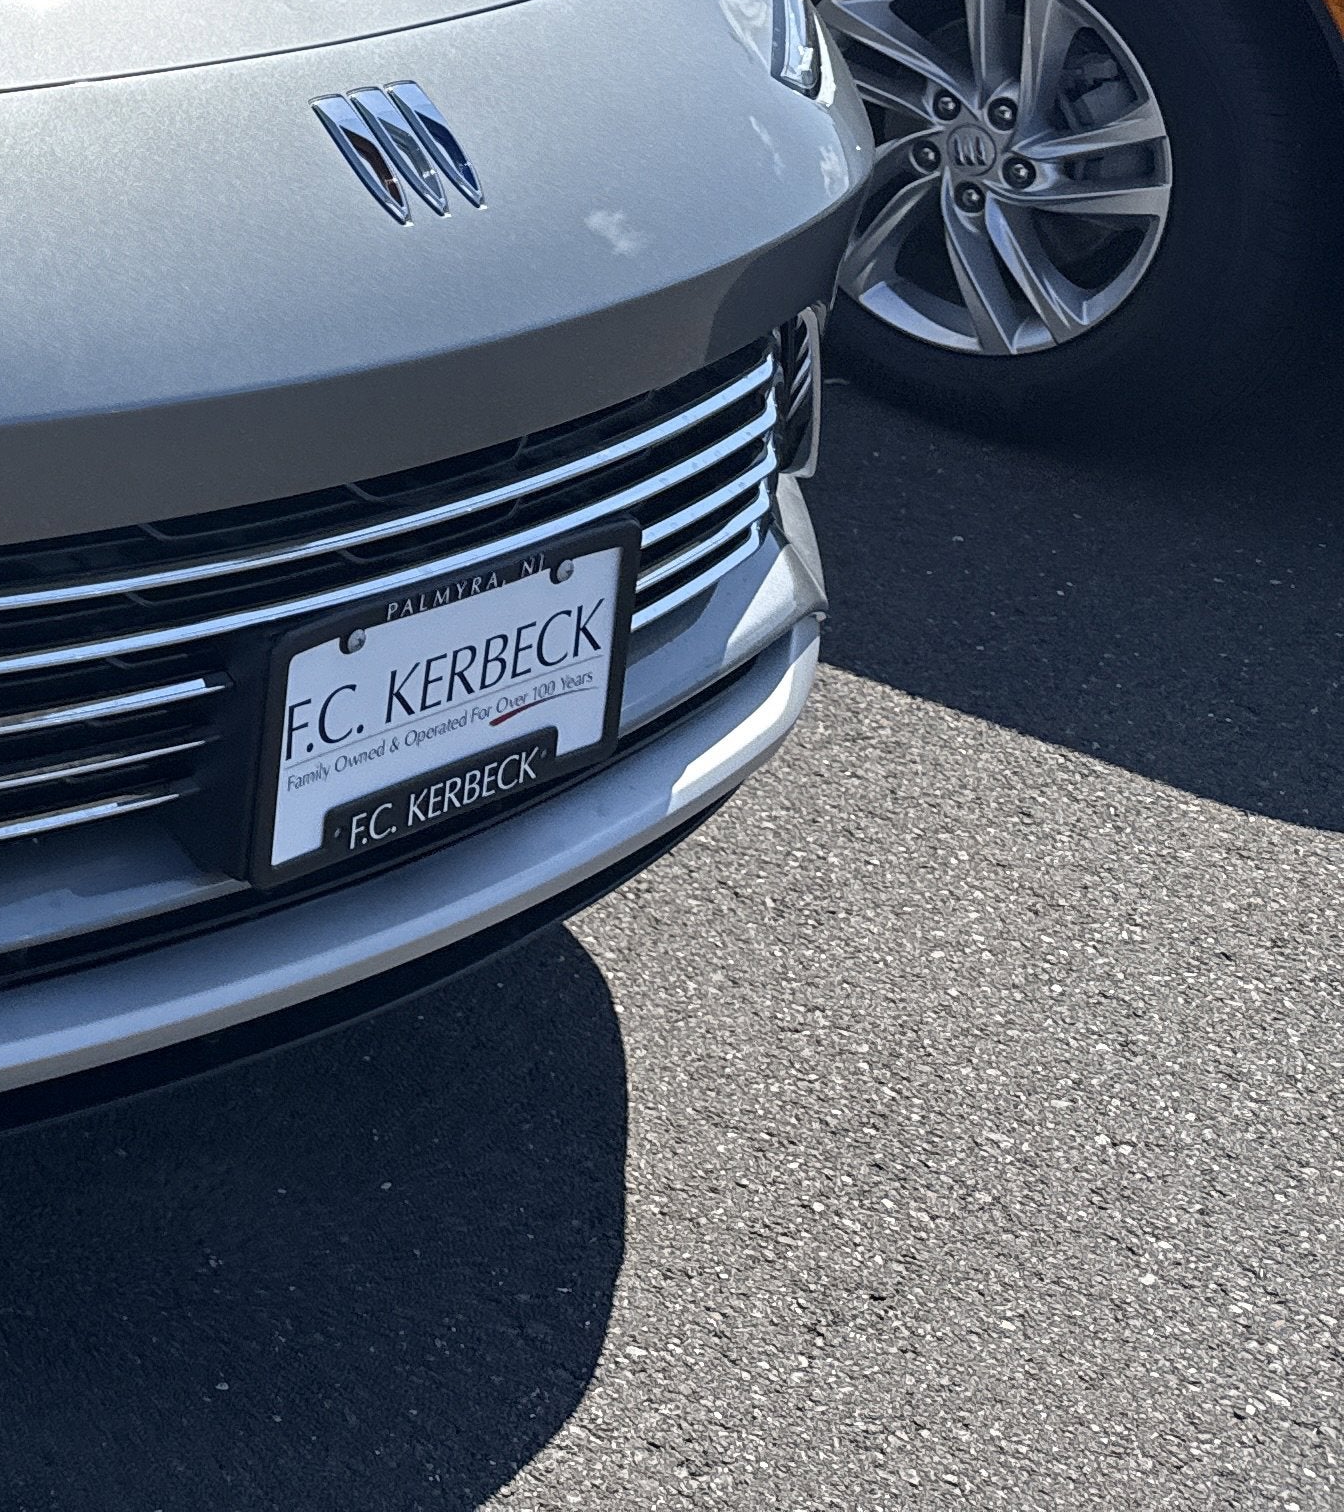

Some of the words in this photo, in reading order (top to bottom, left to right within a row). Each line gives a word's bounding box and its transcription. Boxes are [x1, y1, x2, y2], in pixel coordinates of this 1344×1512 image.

[387, 571, 507, 621] PALMYRA,
[285, 684, 364, 761] F.C.
[385, 598, 605, 724] KERBECK
[287, 762, 330, 792] Family
[334, 739, 386, 773] Owned
[389, 737, 401, 753] &
[404, 710, 468, 747] Operated
[471, 706, 492, 723] For
[496, 692, 528, 713] Over
[532, 681, 556, 700] 100
[561, 672, 594, 690] Years
[349, 803, 397, 849] F.C.
[407, 746, 539, 827] KERBECK
